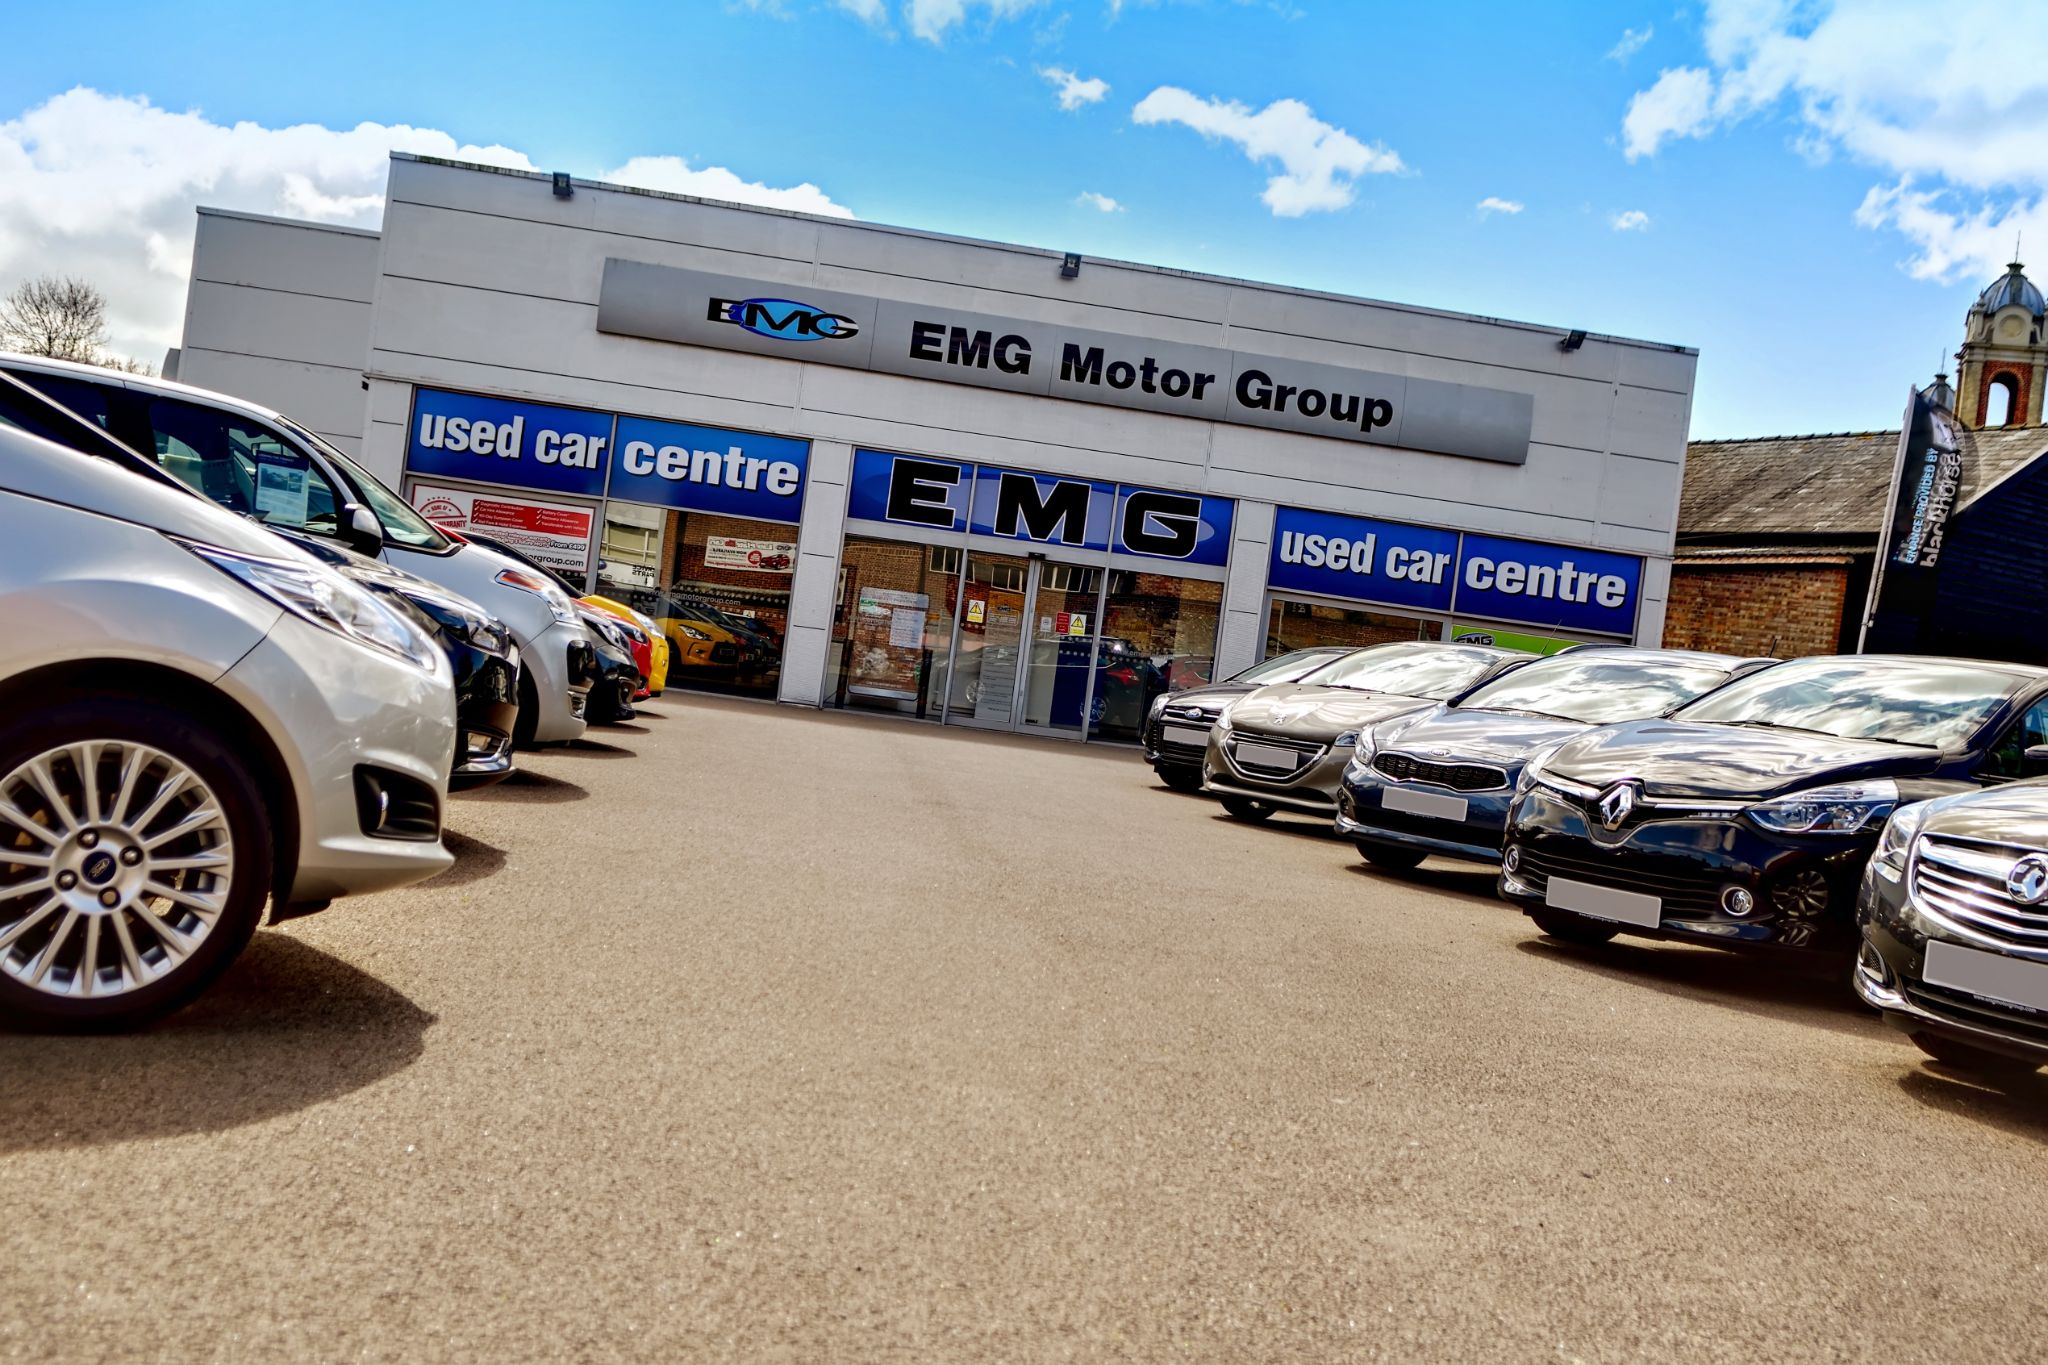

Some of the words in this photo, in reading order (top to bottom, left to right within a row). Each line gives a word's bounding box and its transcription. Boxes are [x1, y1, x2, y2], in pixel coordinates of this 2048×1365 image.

[707, 297, 859, 339] EMG
[909, 320, 1032, 375] EMG
[1059, 342, 1215, 400] Motor
[1235, 369, 1394, 433] Group
[419, 413, 525, 460] used
[534, 429, 606, 470] car
[622, 440, 800, 496] centre
[1925, 448, 1939, 463] BY
[885, 456, 1202, 559] EMG
[1915, 464, 1936, 518] PROVIDED
[551, 540, 567, 549] From
[569, 543, 586, 551] £499
[1906, 519, 1924, 564] FINANCE
[1279, 530, 1377, 575] used
[1384, 546, 1451, 585] car
[1465, 556, 1627, 608] centre
